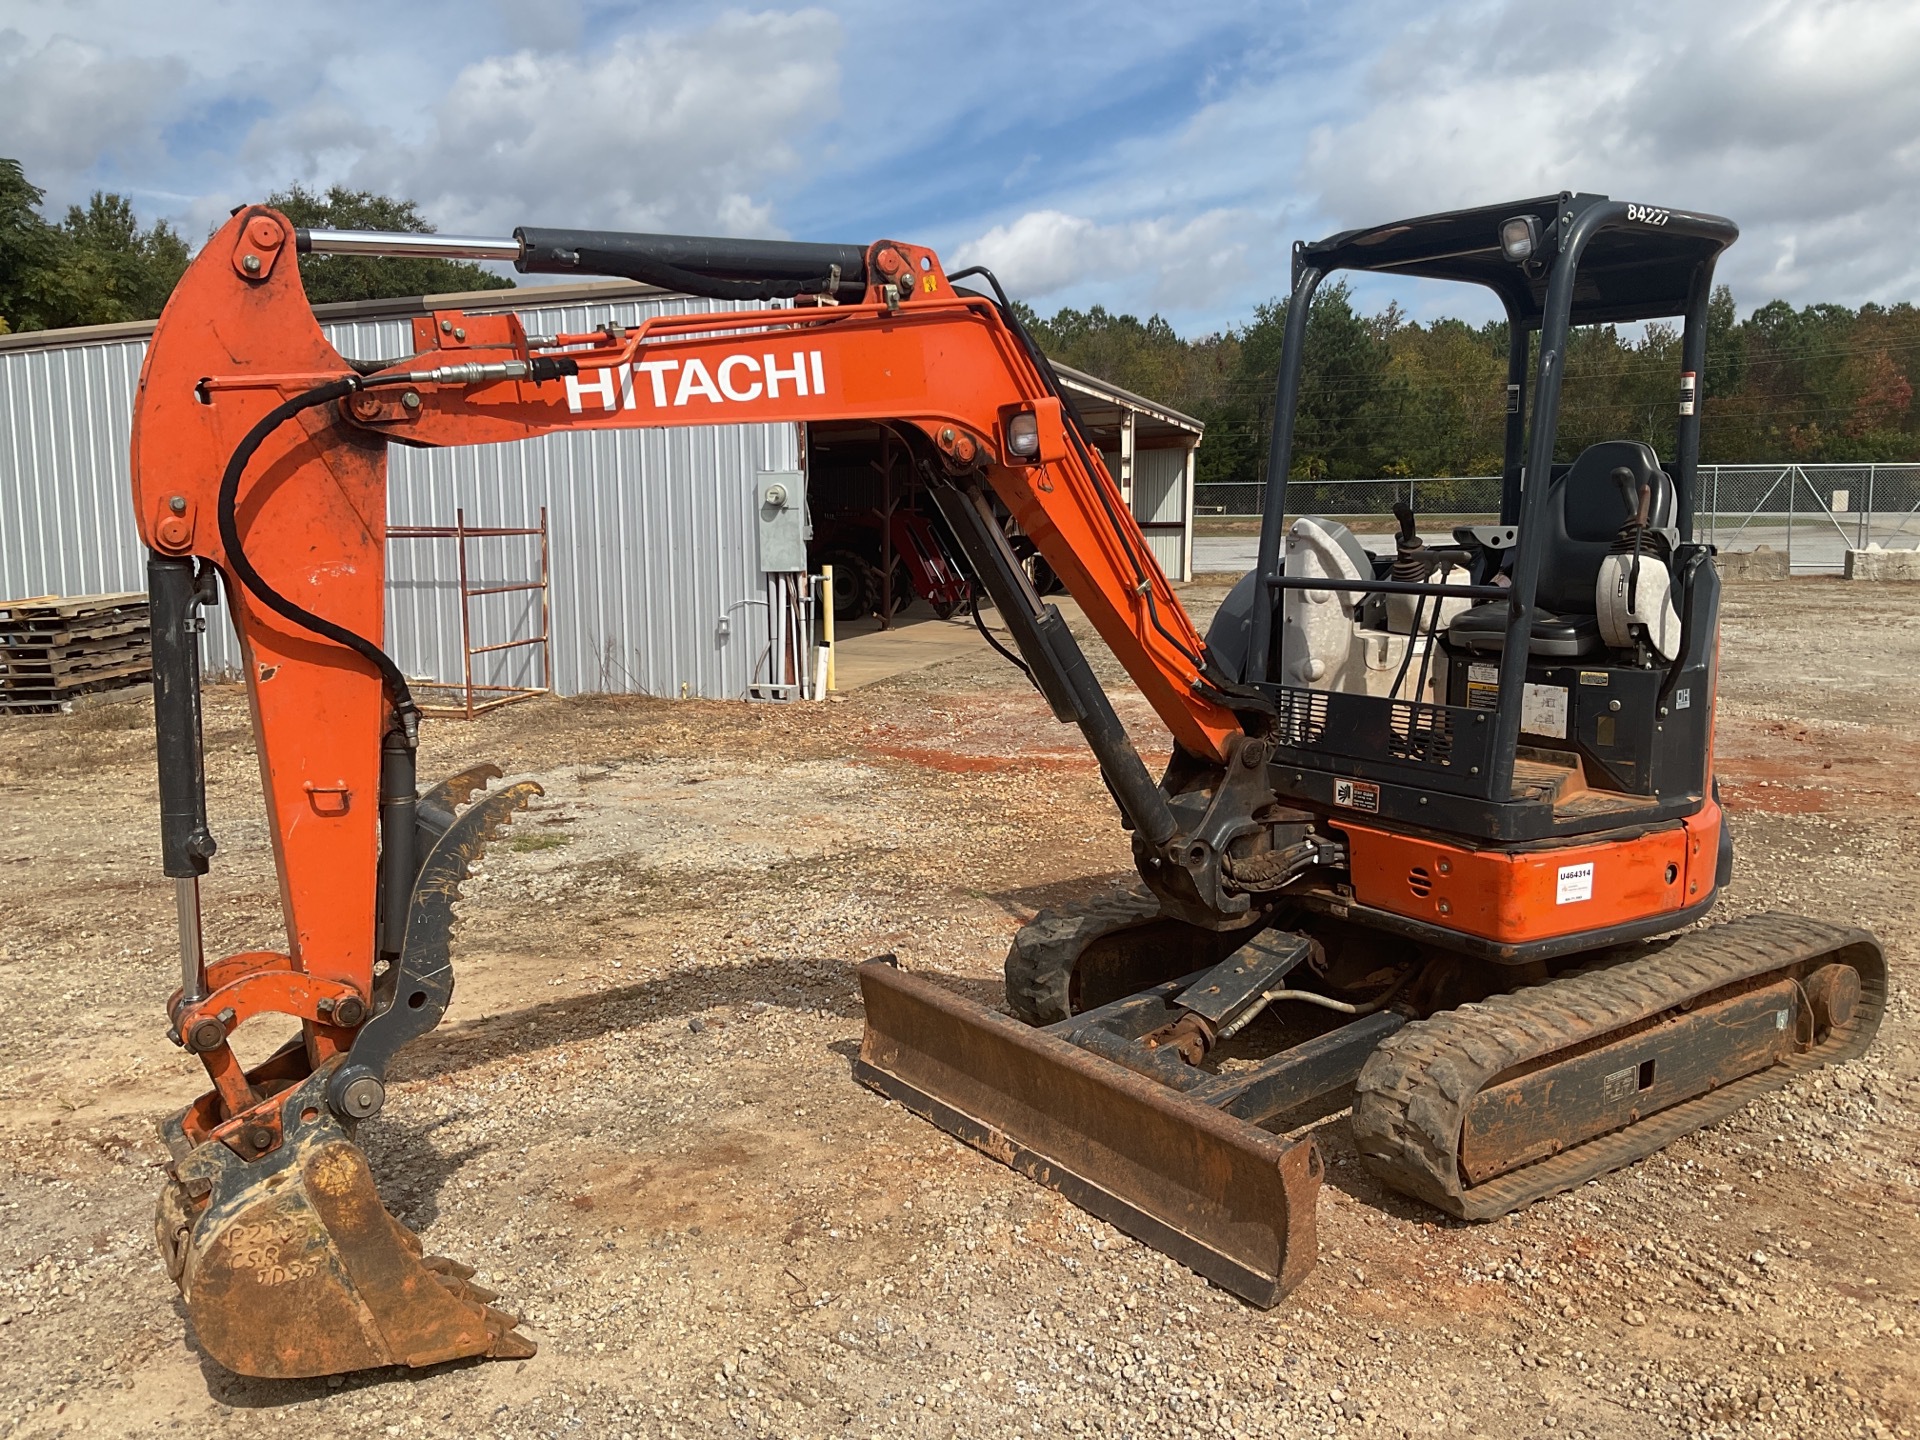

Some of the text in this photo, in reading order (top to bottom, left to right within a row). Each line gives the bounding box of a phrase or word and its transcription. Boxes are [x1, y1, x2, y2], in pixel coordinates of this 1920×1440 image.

[1627, 204, 1670, 226] 84227
[564, 350, 826, 414] HITACHI
[1560, 869, 1591, 880] U464314
